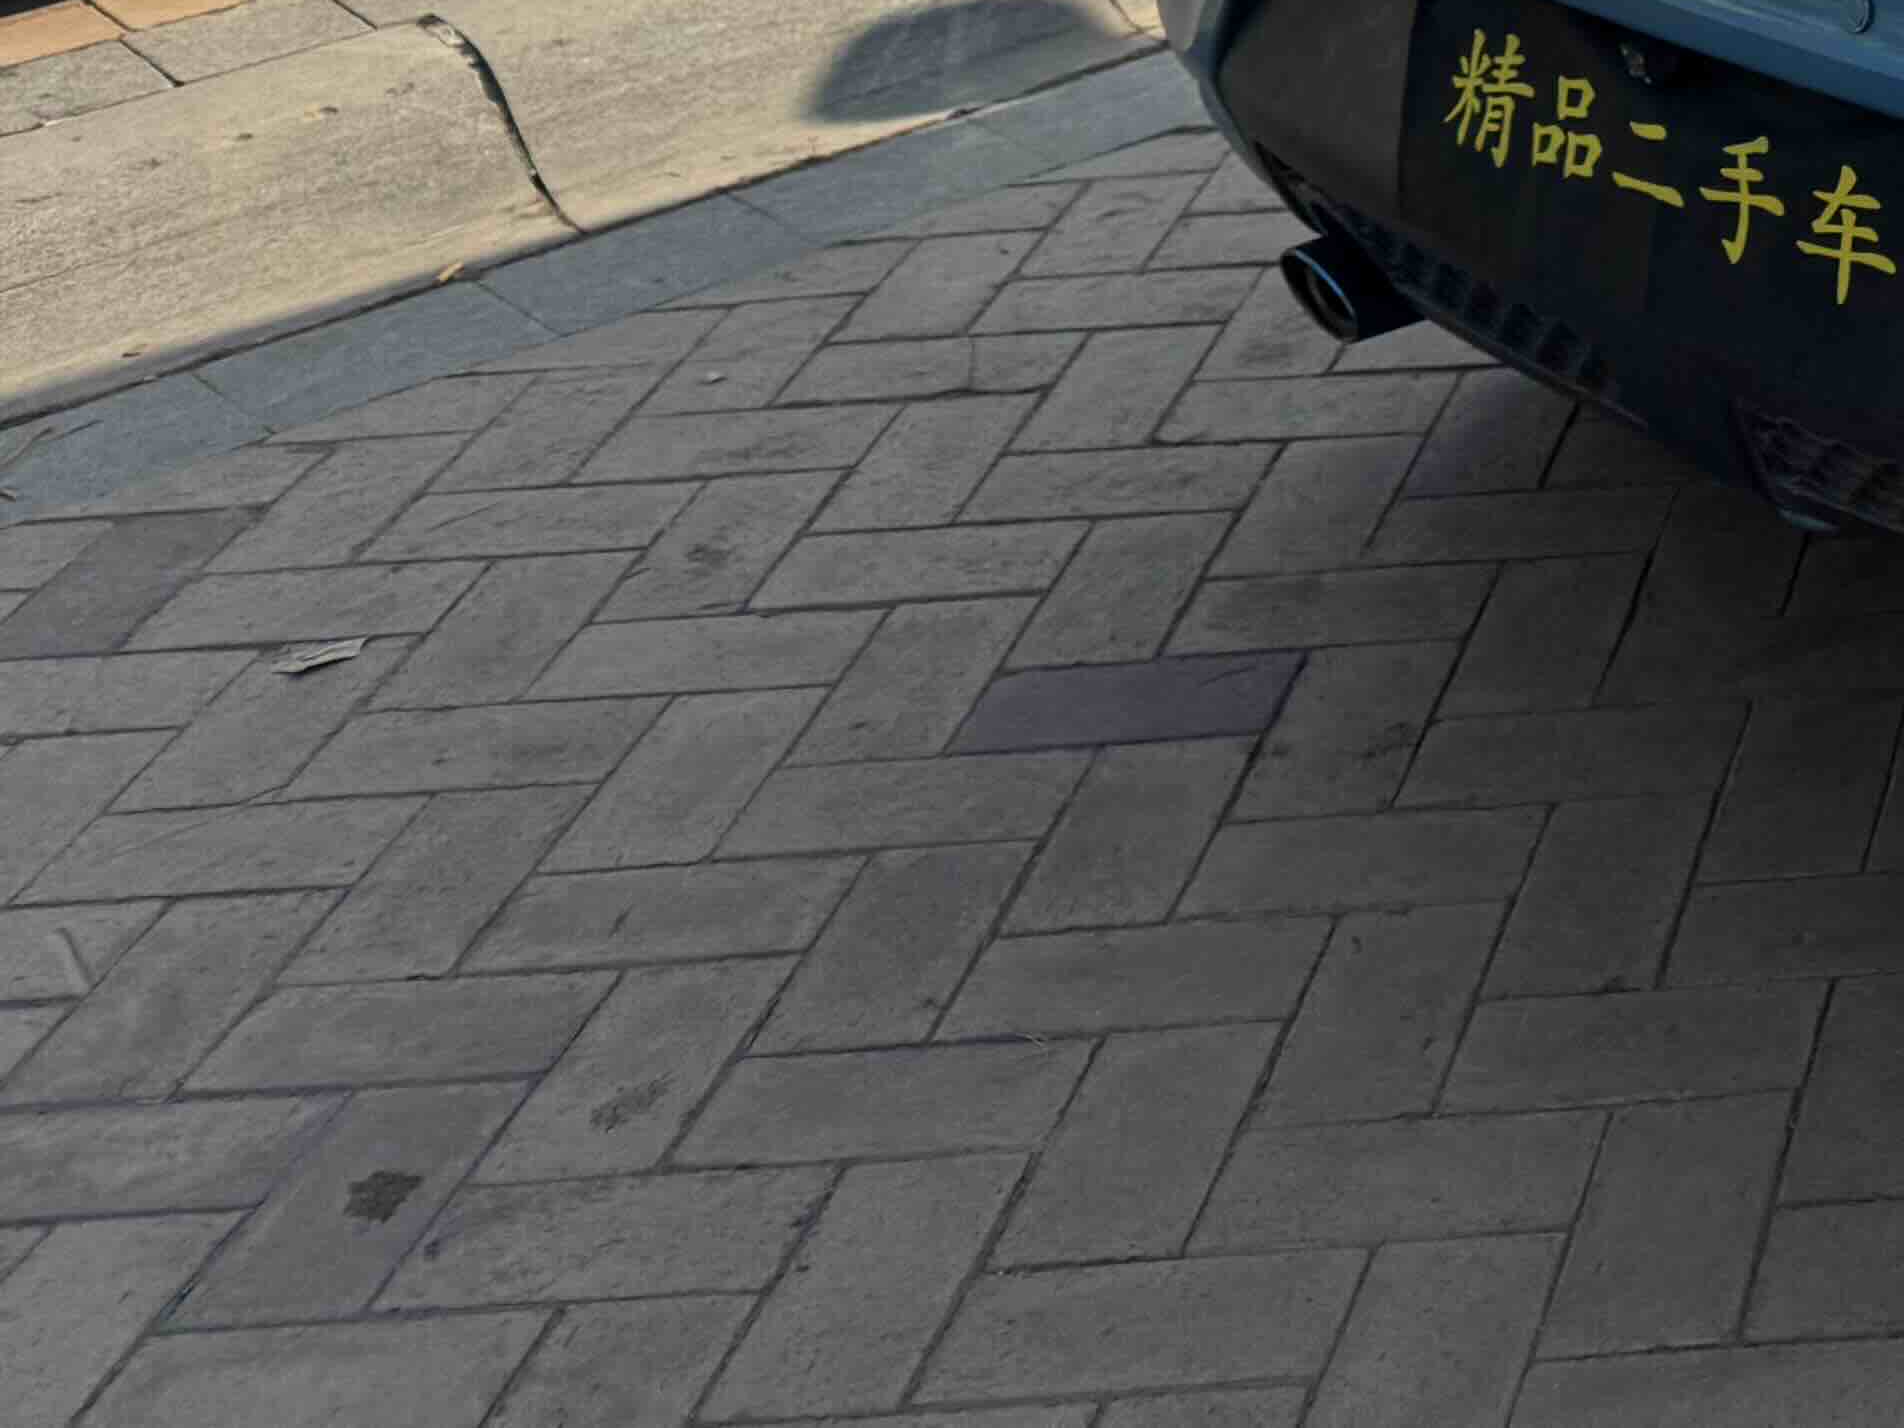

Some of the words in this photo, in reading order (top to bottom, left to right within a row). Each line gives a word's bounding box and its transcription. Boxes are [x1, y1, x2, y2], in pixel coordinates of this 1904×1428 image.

[1443, 28, 1897, 306] 精品二手车
